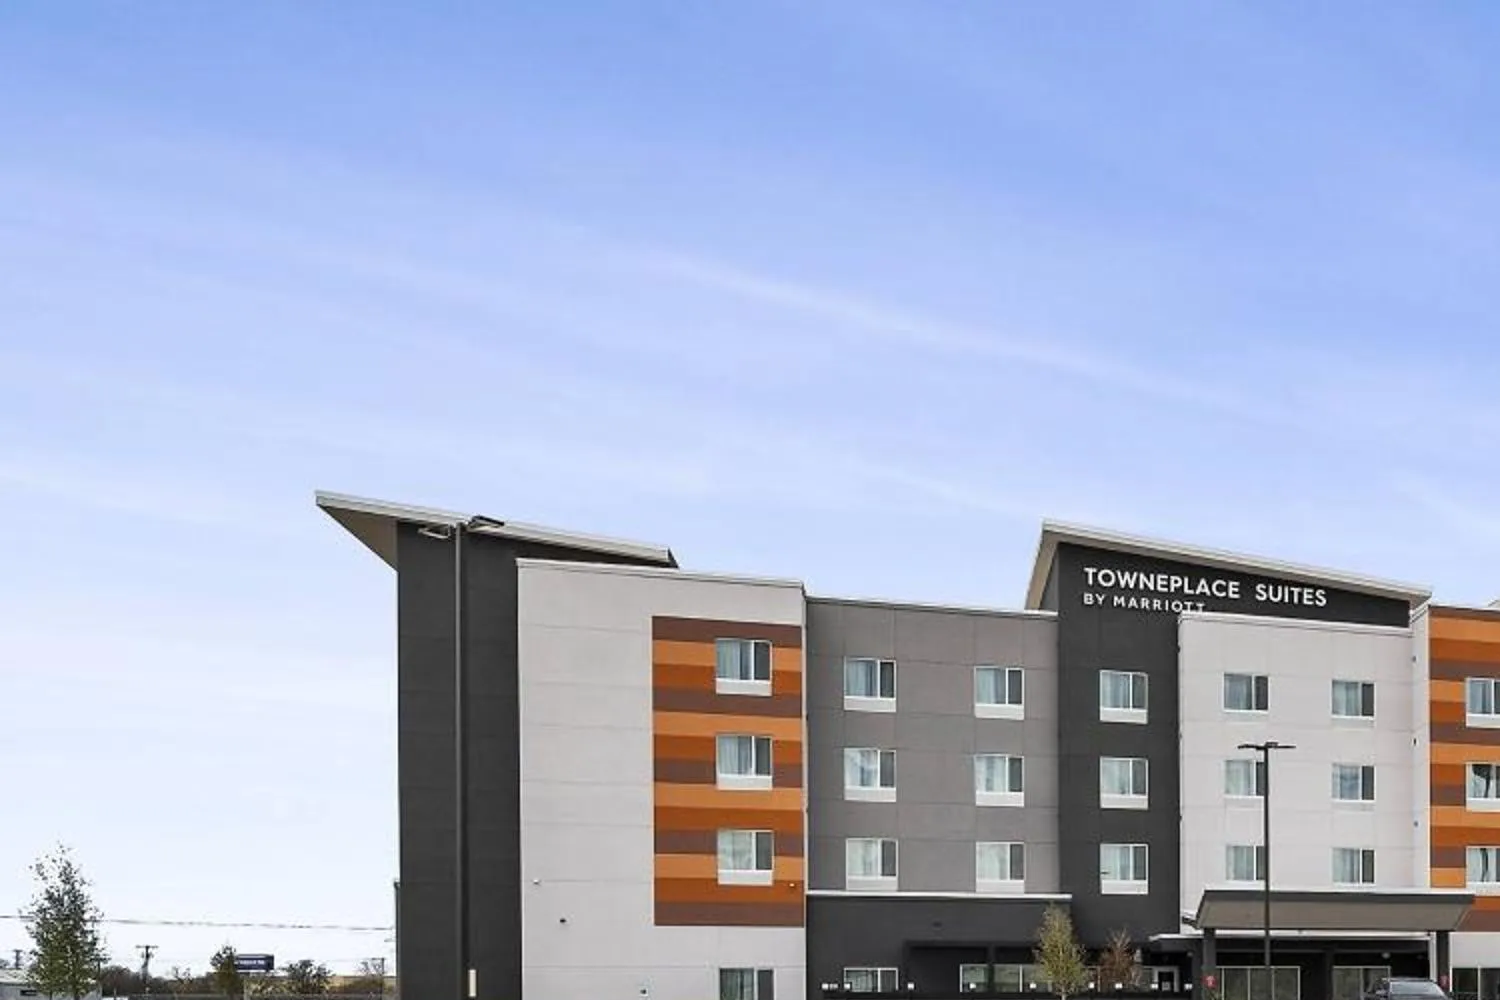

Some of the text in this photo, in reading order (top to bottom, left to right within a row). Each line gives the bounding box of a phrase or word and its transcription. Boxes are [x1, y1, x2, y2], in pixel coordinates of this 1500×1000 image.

[1083, 567, 1327, 607] TOWNEPLACE SUITES
[1083, 593, 1206, 613] BY MARRIOTT
